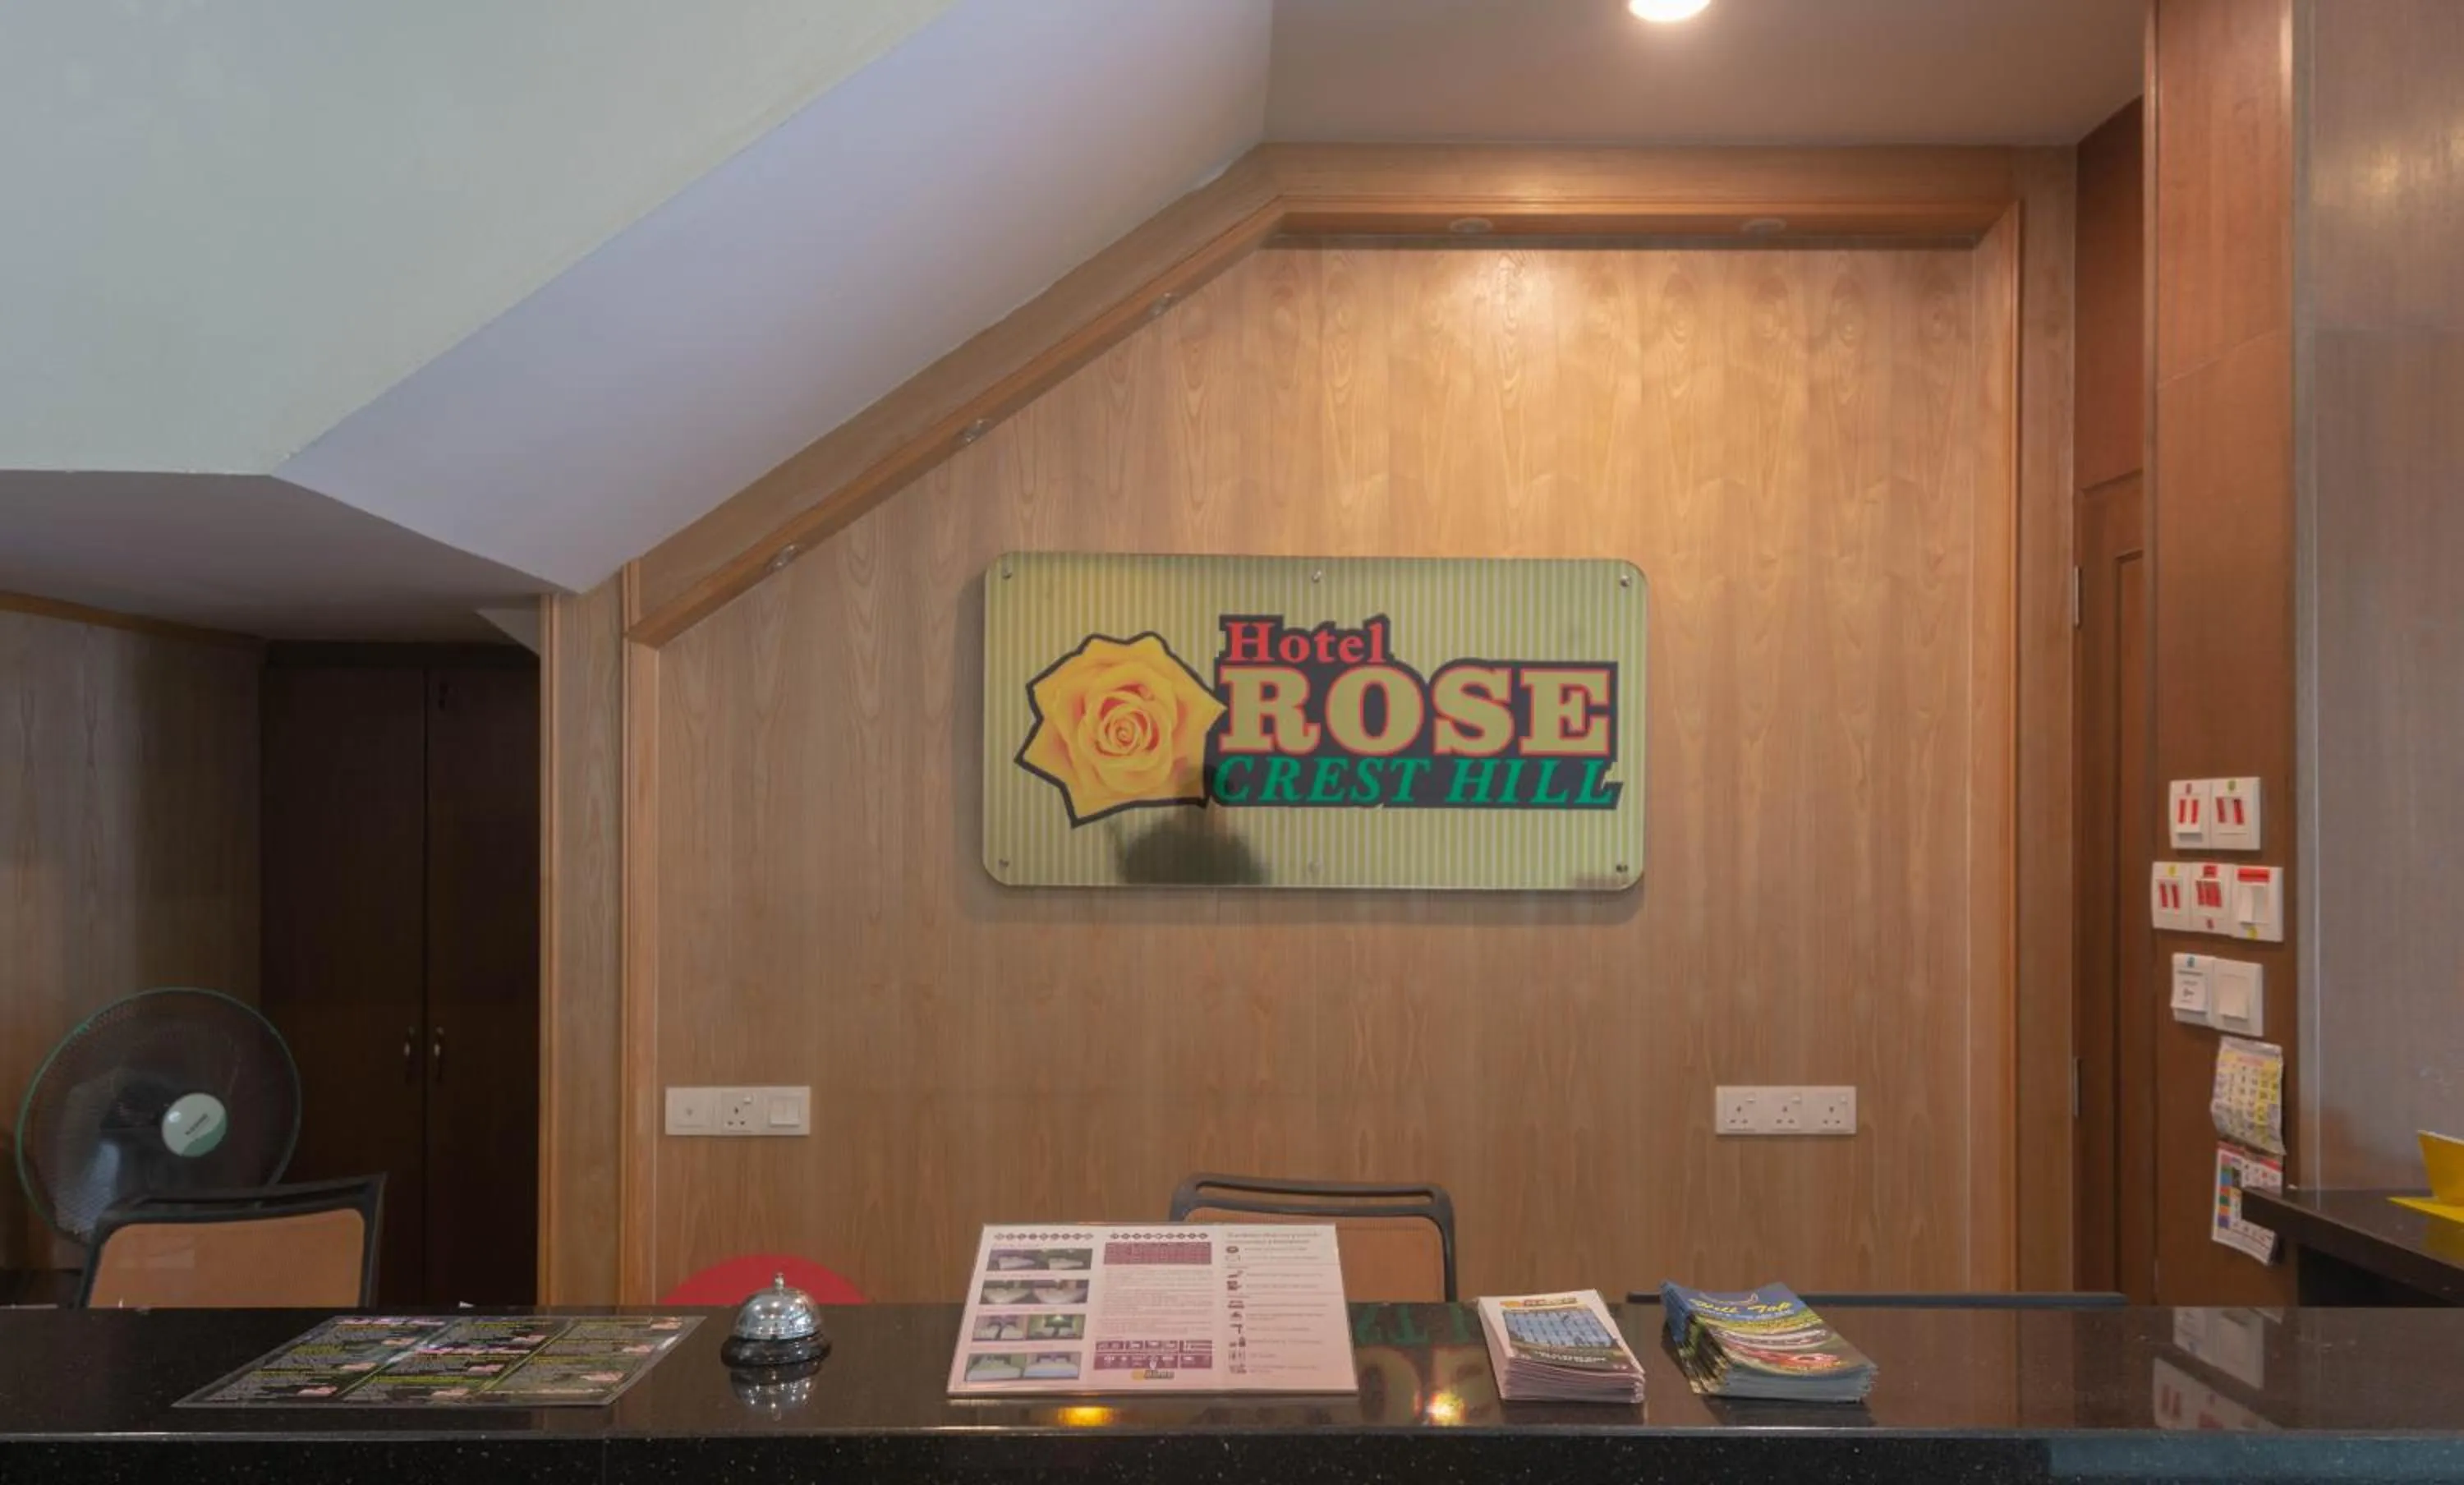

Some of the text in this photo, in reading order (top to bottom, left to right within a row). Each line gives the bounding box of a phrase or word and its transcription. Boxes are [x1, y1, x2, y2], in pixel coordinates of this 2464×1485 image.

[1225, 620, 1387, 664] Hotel
[1218, 664, 1611, 757] ROSE
[1211, 755, 1615, 805] CREST HILL
